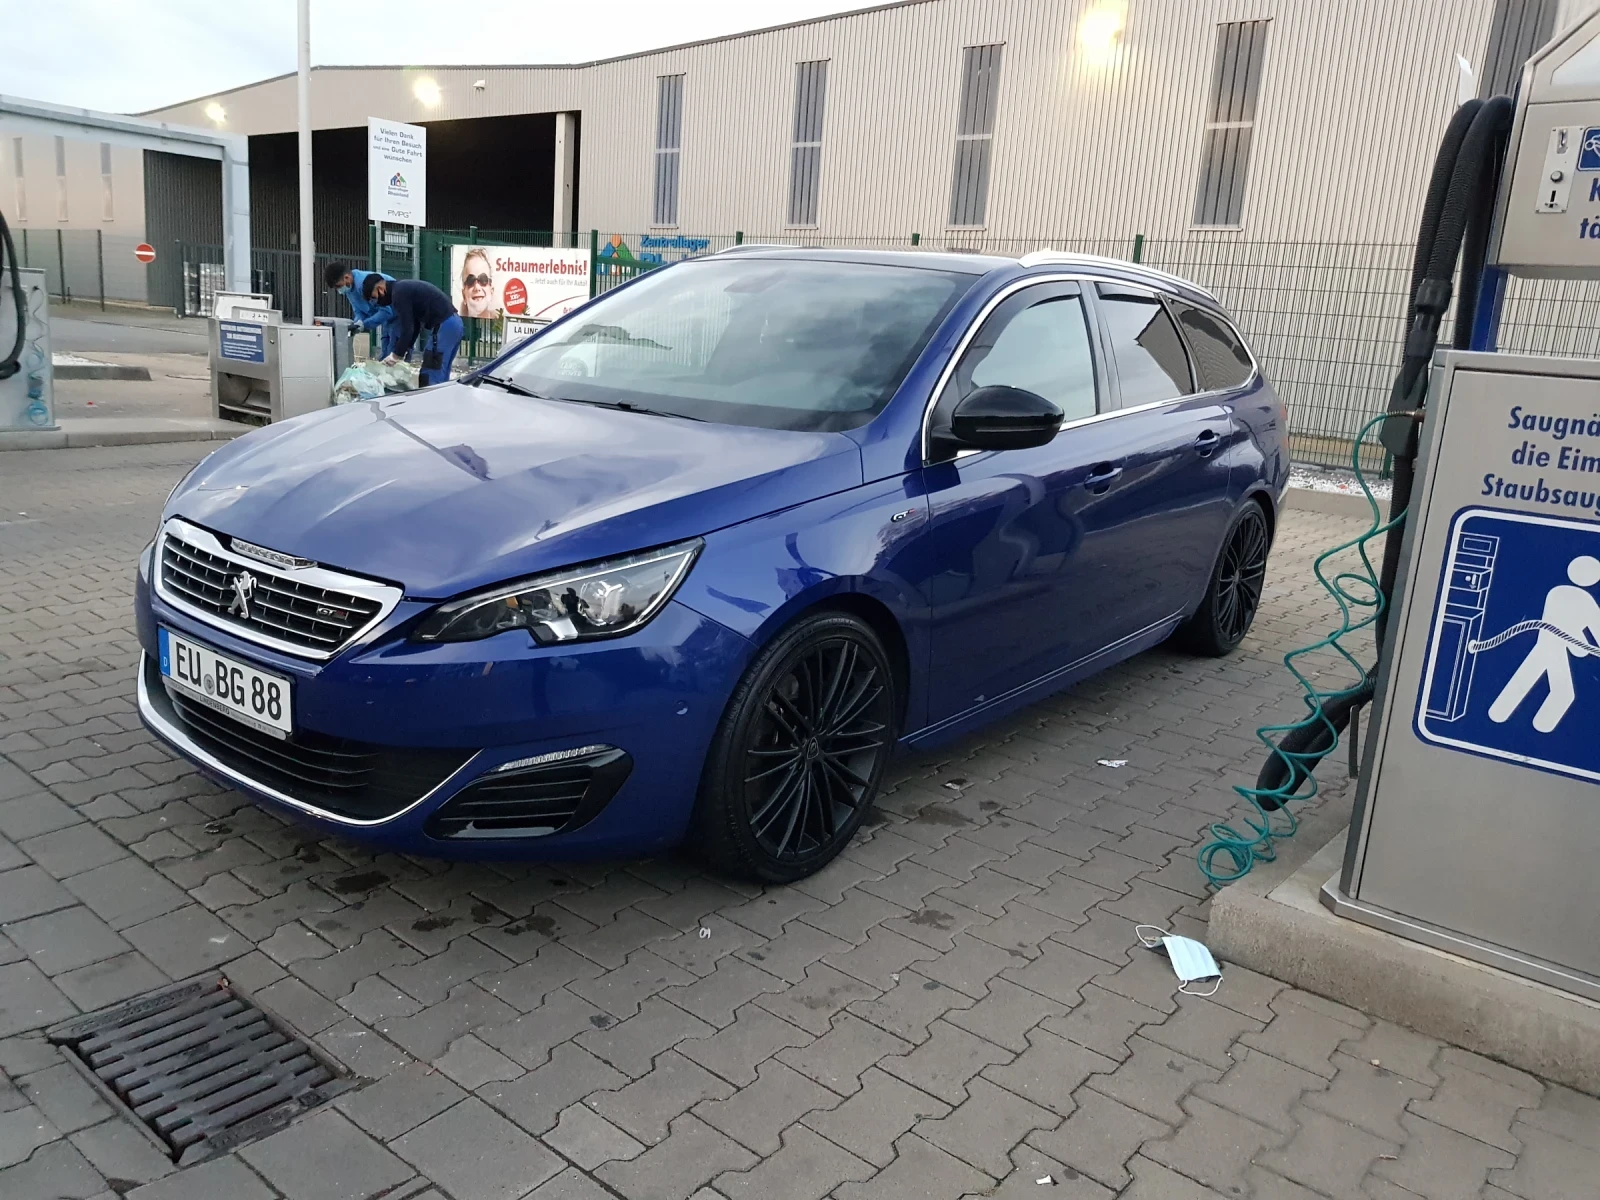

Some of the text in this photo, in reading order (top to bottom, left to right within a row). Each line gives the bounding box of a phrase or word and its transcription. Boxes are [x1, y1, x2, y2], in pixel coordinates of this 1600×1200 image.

[380, 128, 413, 140] Vielen Dank
[385, 137, 400, 145] Ihren
[402, 140, 422, 149] Besuch
[392, 146, 405, 154] Gute
[407, 149, 422, 157] Fahrt
[384, 154, 412, 163] wünschen
[640, 234, 710, 252] Zentrallager
[496, 257, 588, 276] Schaumerlebnis!
[1511, 441, 1550, 467] die
[163, 657, 168, 667] D
[176, 641, 282, 721] EU BG 88
